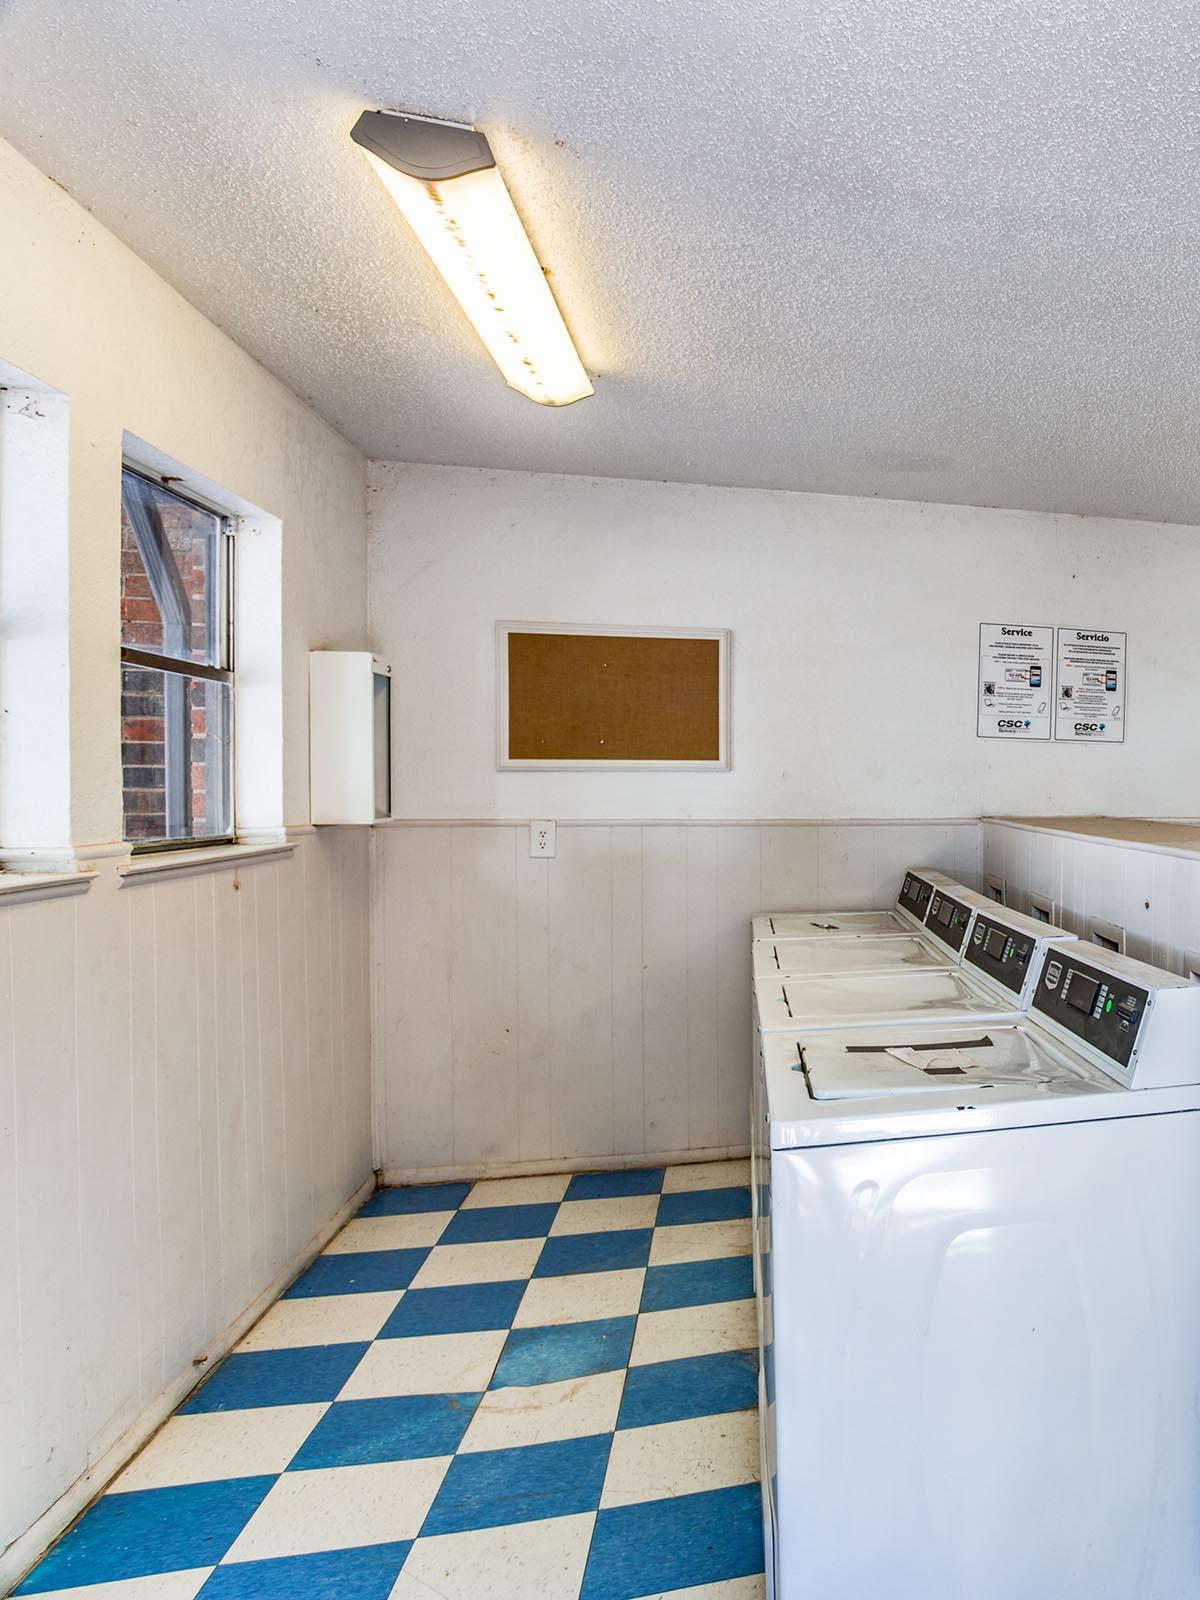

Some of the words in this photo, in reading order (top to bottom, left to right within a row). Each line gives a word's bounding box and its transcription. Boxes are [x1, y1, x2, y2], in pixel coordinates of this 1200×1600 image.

[1001, 627, 1033, 637] Service
[1076, 632, 1109, 642] Servicio
[997, 719, 1023, 728] CSC
[1074, 722, 1098, 731] CSC
